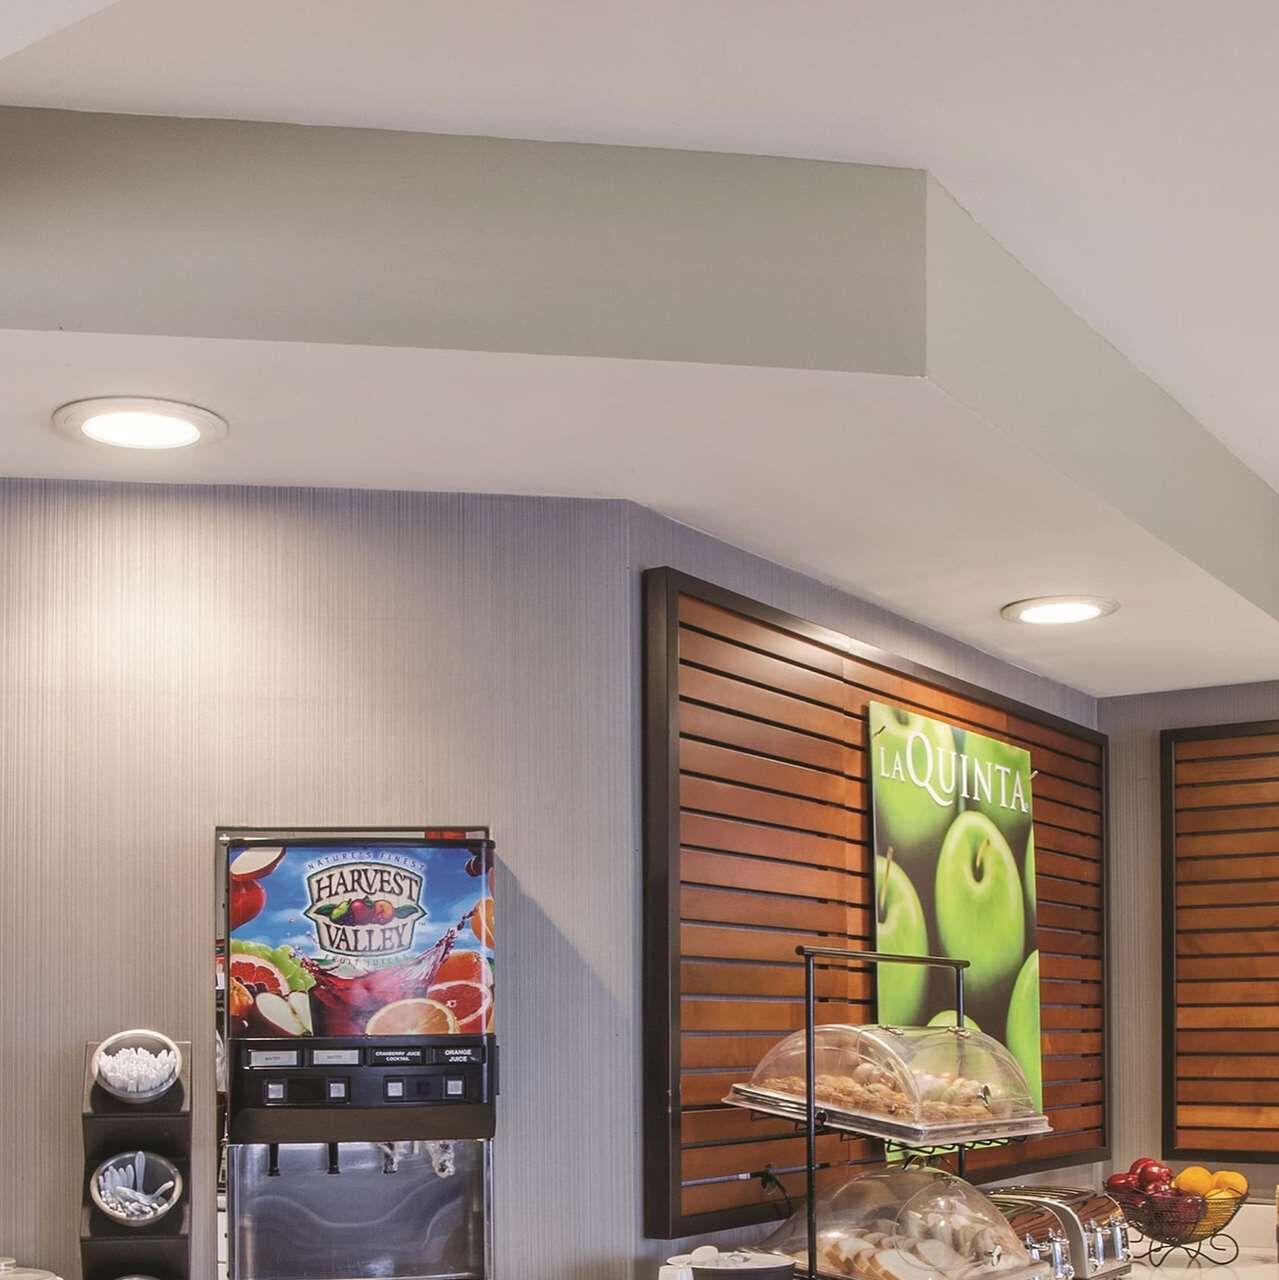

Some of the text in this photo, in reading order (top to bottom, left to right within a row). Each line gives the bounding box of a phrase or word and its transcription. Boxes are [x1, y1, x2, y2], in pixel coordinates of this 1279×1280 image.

[879, 732, 1028, 813] LA QUINTA
[307, 851, 426, 871] NATURE'S FINEST
[315, 868, 419, 903] HARVEST
[323, 922, 409, 952] VALLEY
